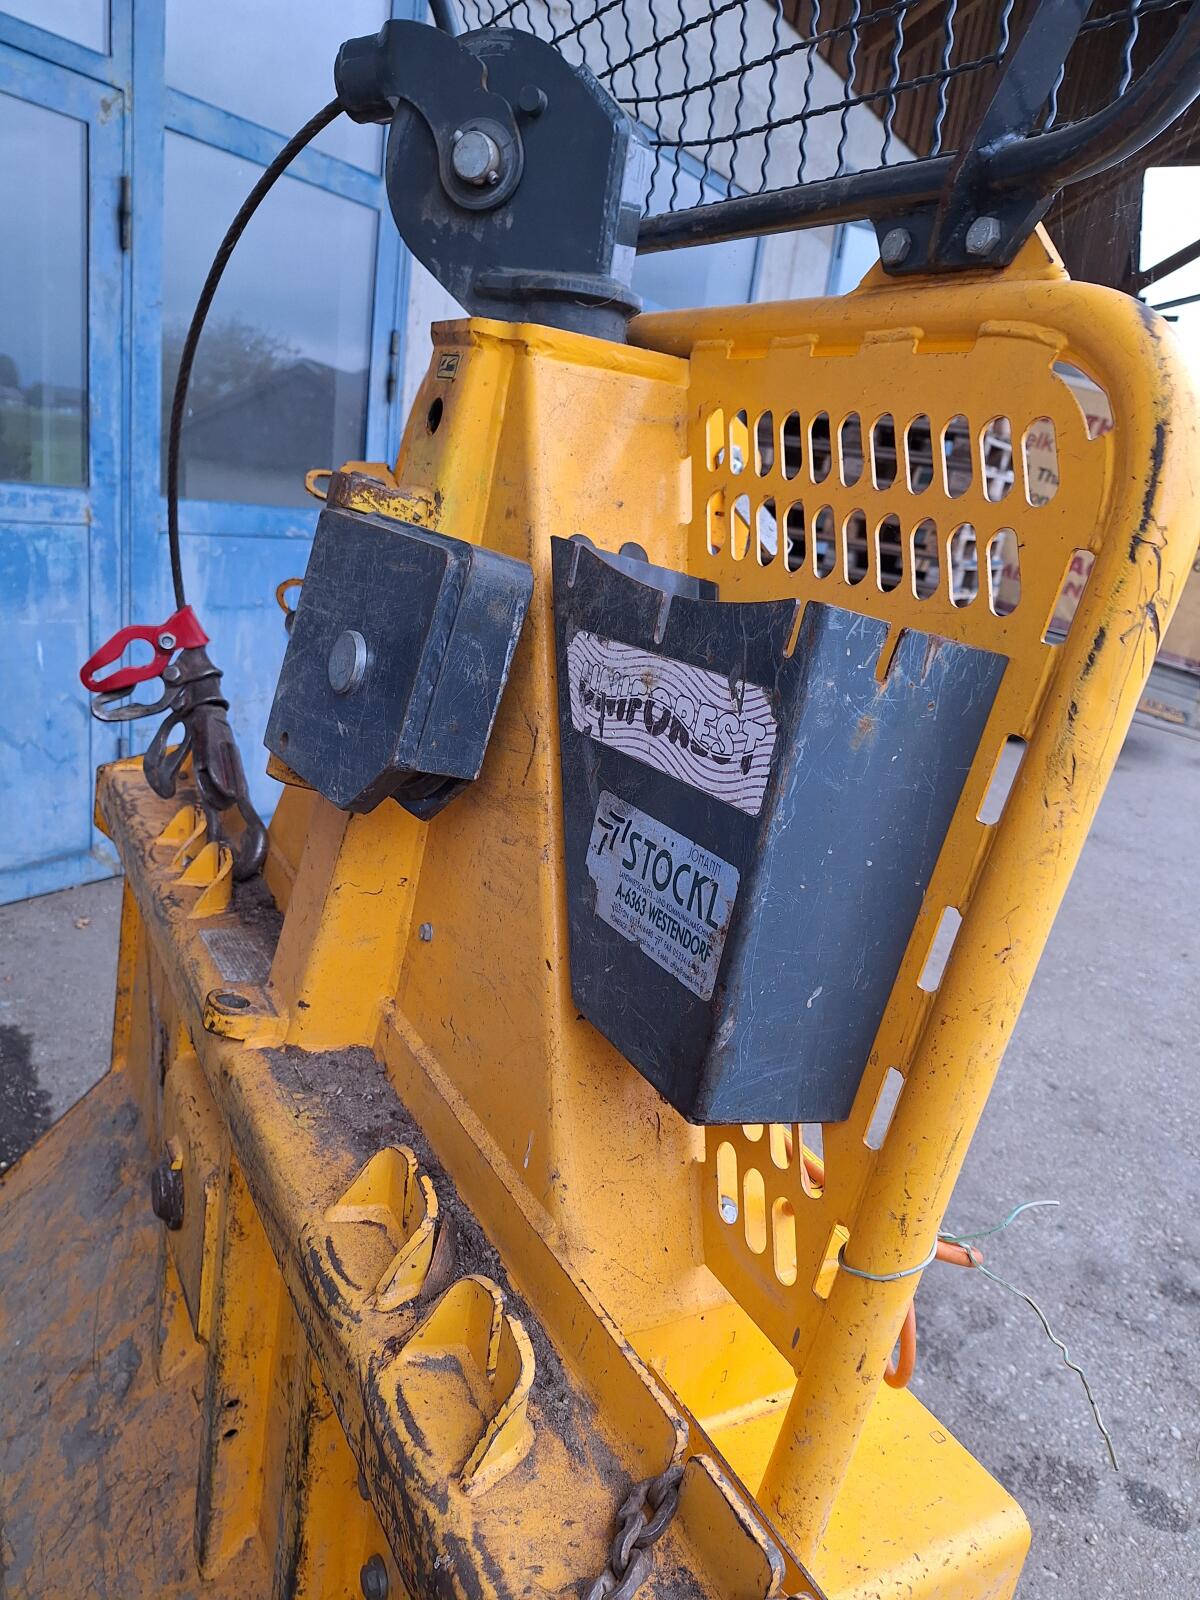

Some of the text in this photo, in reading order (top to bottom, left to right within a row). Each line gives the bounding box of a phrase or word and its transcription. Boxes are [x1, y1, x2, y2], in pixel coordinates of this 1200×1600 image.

[614, 880, 647, 917] A-6363
[646, 903, 712, 965] WESTENDORF
[621, 831, 719, 931] STÖCKL
